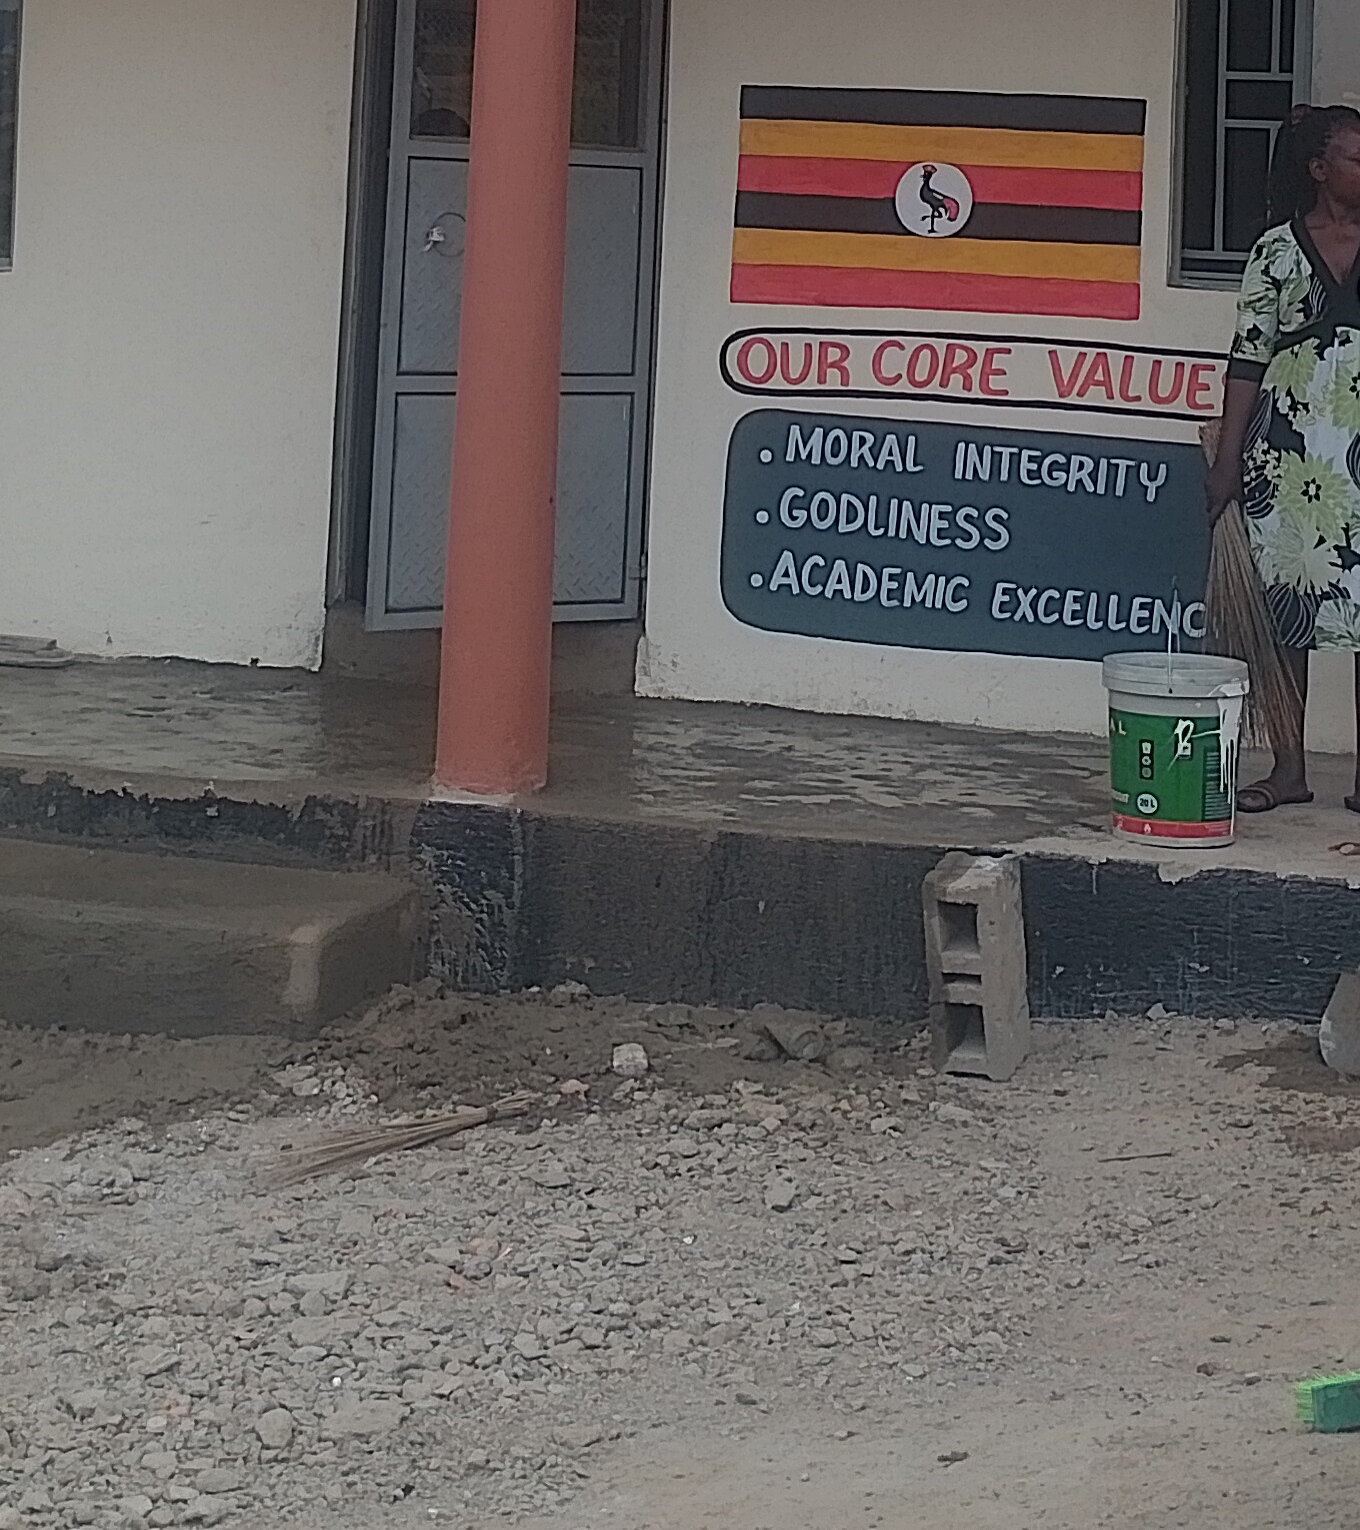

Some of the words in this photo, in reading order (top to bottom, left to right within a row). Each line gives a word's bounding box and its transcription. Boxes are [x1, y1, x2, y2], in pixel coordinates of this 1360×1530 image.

[737, 337, 850, 387] OUR
[871, 340, 1012, 397] CORE
[1047, 348, 1227, 411] VALUE
[785, 424, 924, 472] MORAL
[954, 441, 1167, 502] INTEGRITY
[779, 487, 1010, 550] GODLINESS
[769, 550, 971, 612] ACADEMIC
[991, 582, 1220, 640] EXCELLENC
